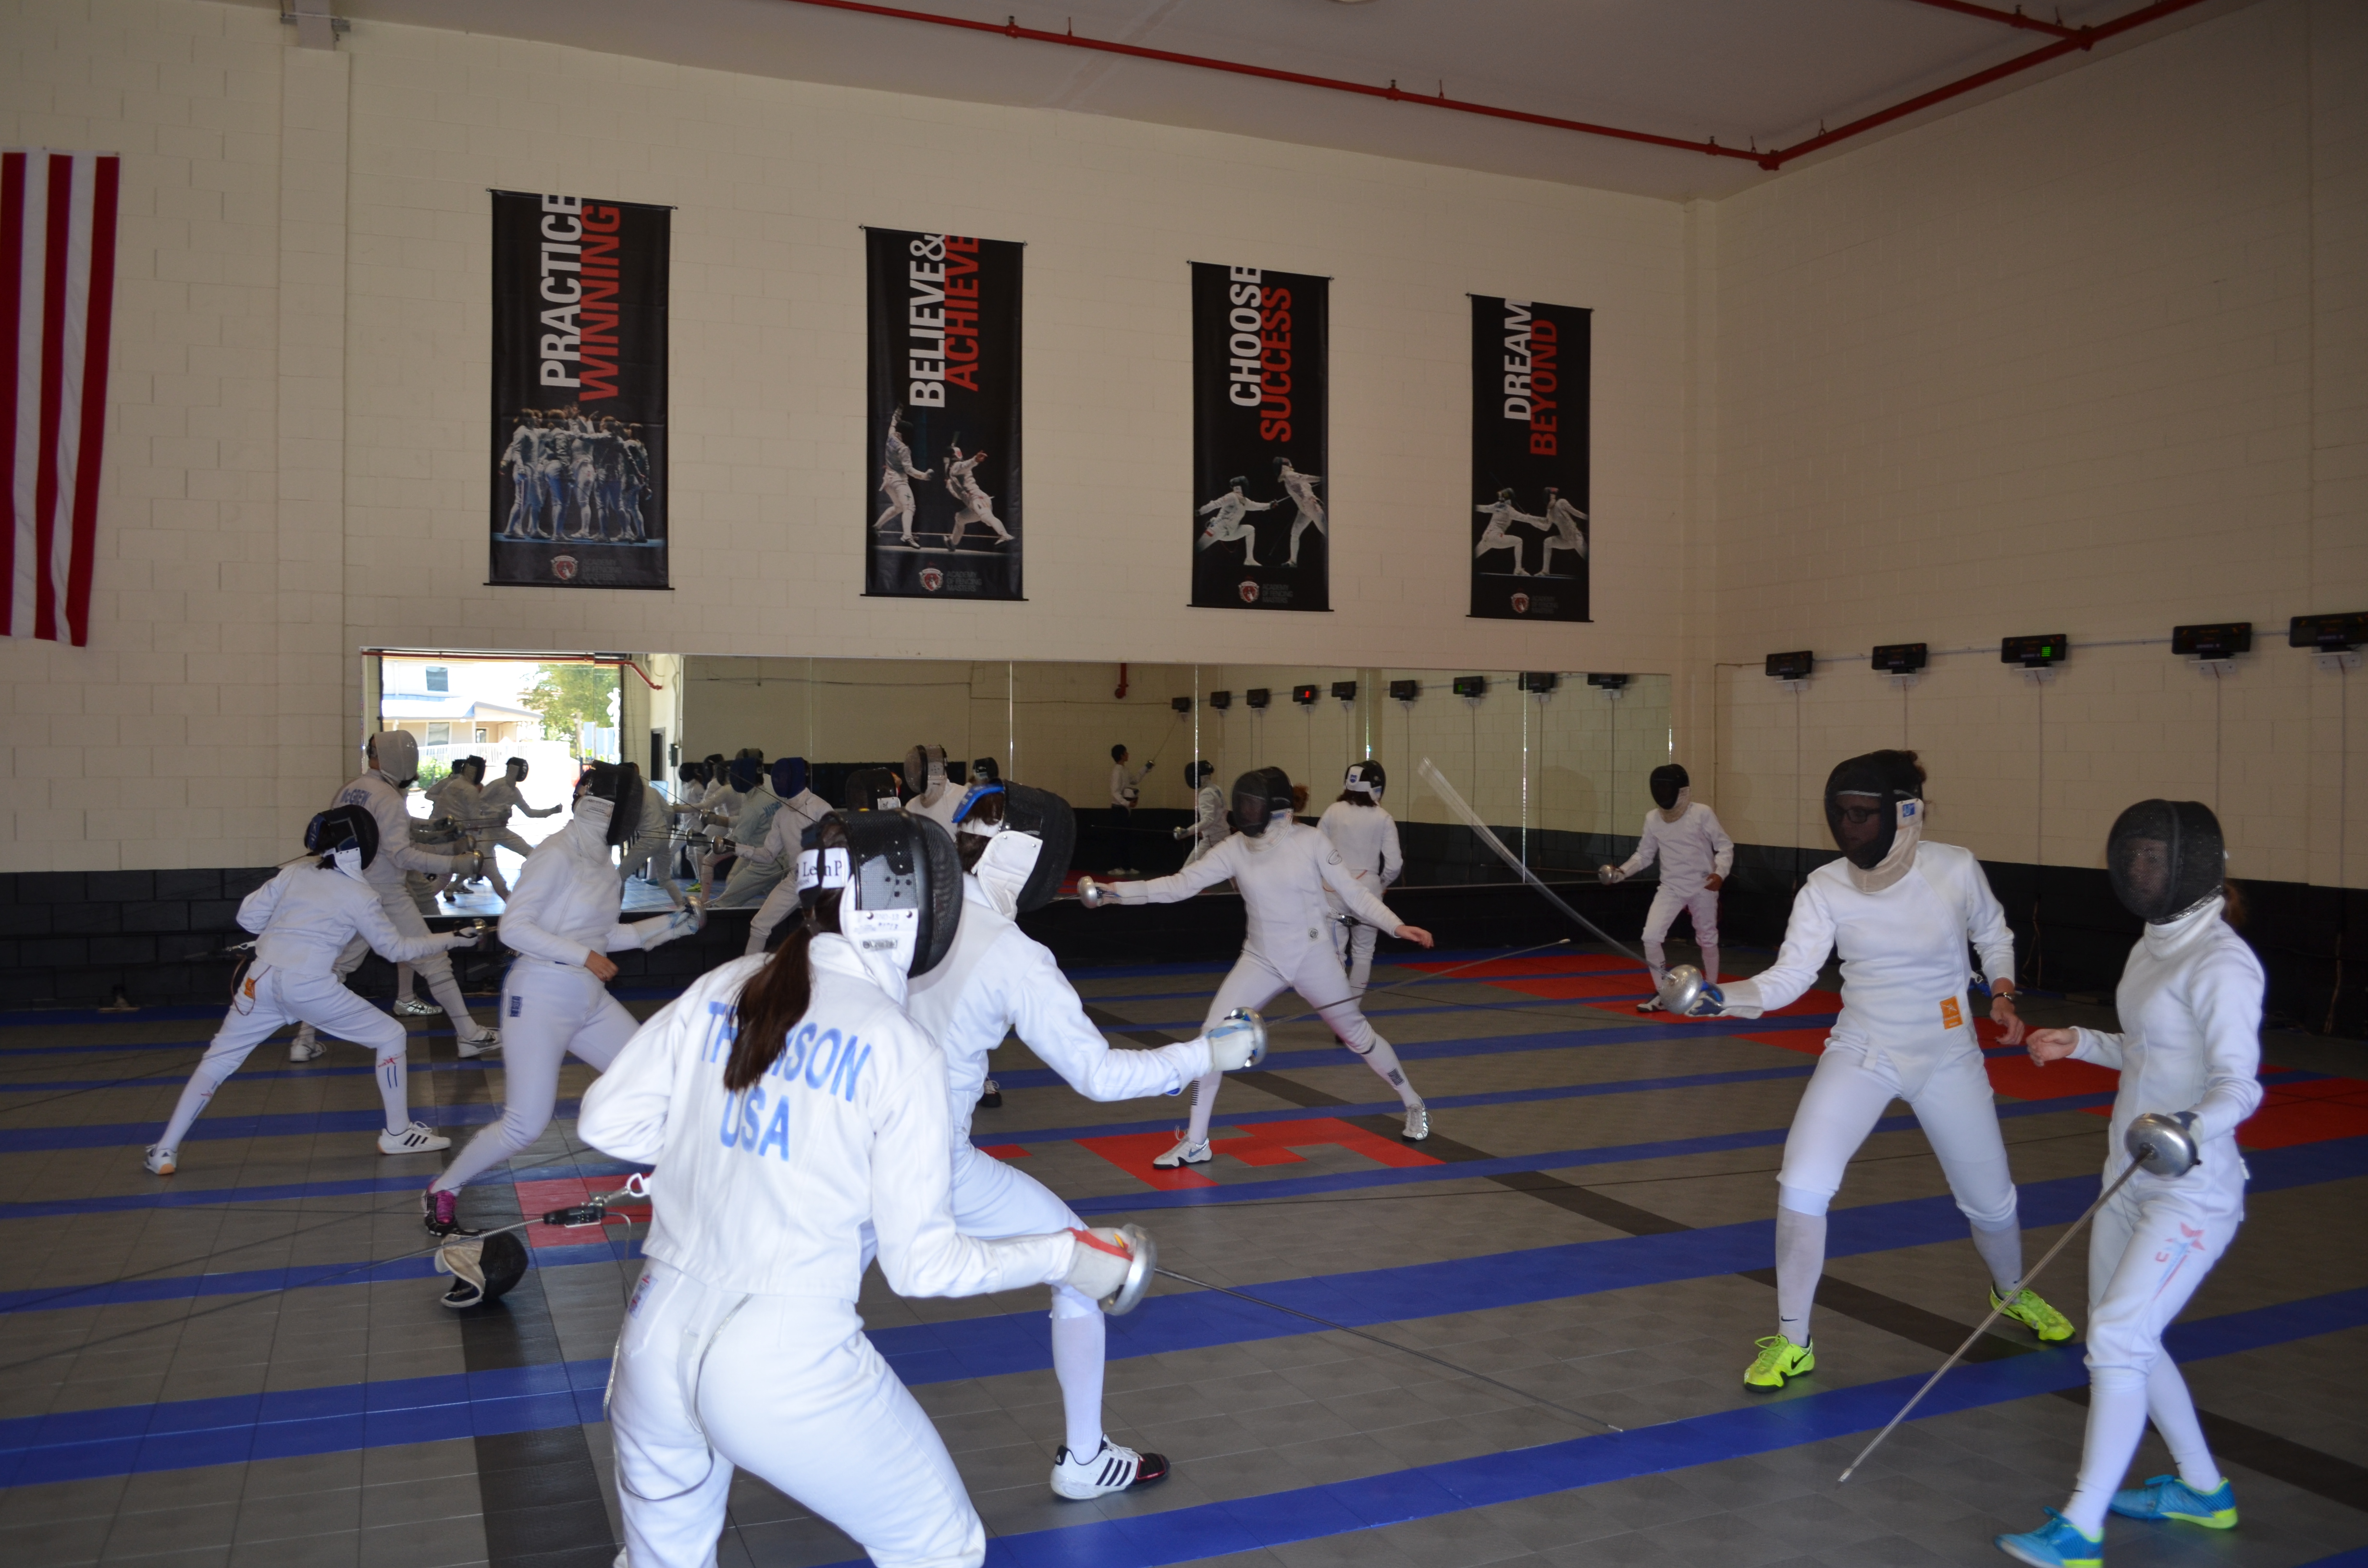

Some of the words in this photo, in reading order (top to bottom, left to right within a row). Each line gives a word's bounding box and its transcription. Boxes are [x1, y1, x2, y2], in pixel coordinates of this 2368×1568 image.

[540, 194, 582, 387] PRACTICE
[579, 205, 621, 402] WINNING
[943, 234, 980, 392] ACHIEVE
[1229, 265, 1262, 407] CHOOSE
[1504, 299, 1532, 421] DREAM
[1260, 286, 1292, 442] SUCCESS
[1529, 319, 1558, 456] BEYOND
[803, 862, 831, 876] Len
[720, 1086, 789, 1162] USA
